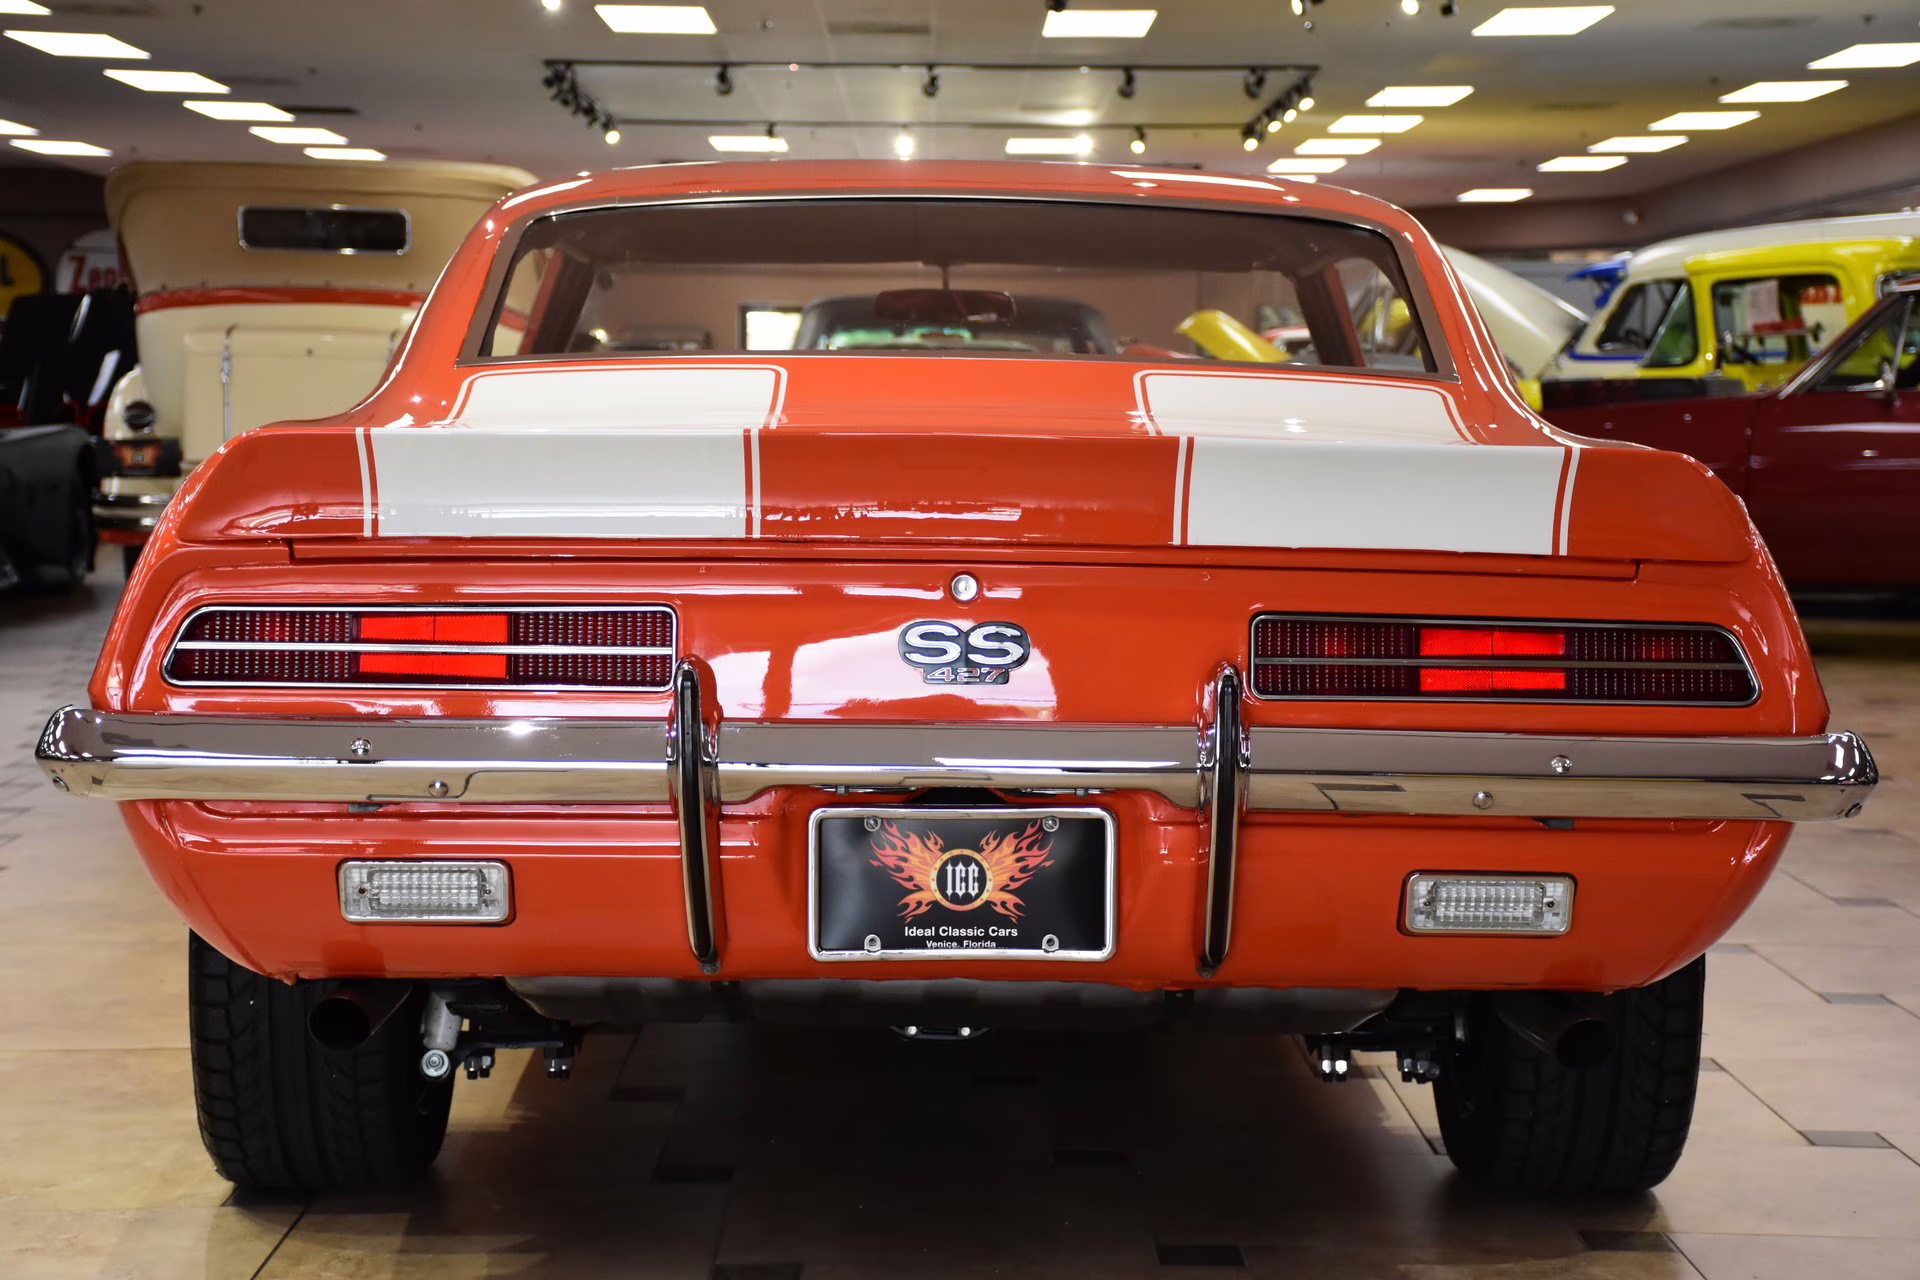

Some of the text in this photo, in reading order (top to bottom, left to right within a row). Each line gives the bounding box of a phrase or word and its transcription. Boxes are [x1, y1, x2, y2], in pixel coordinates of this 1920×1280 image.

[904, 624, 1024, 664] SS
[926, 666, 1006, 682] 427
[904, 926, 1018, 937] Ideal Classic Cars
[963, 940, 996, 948] Florida
